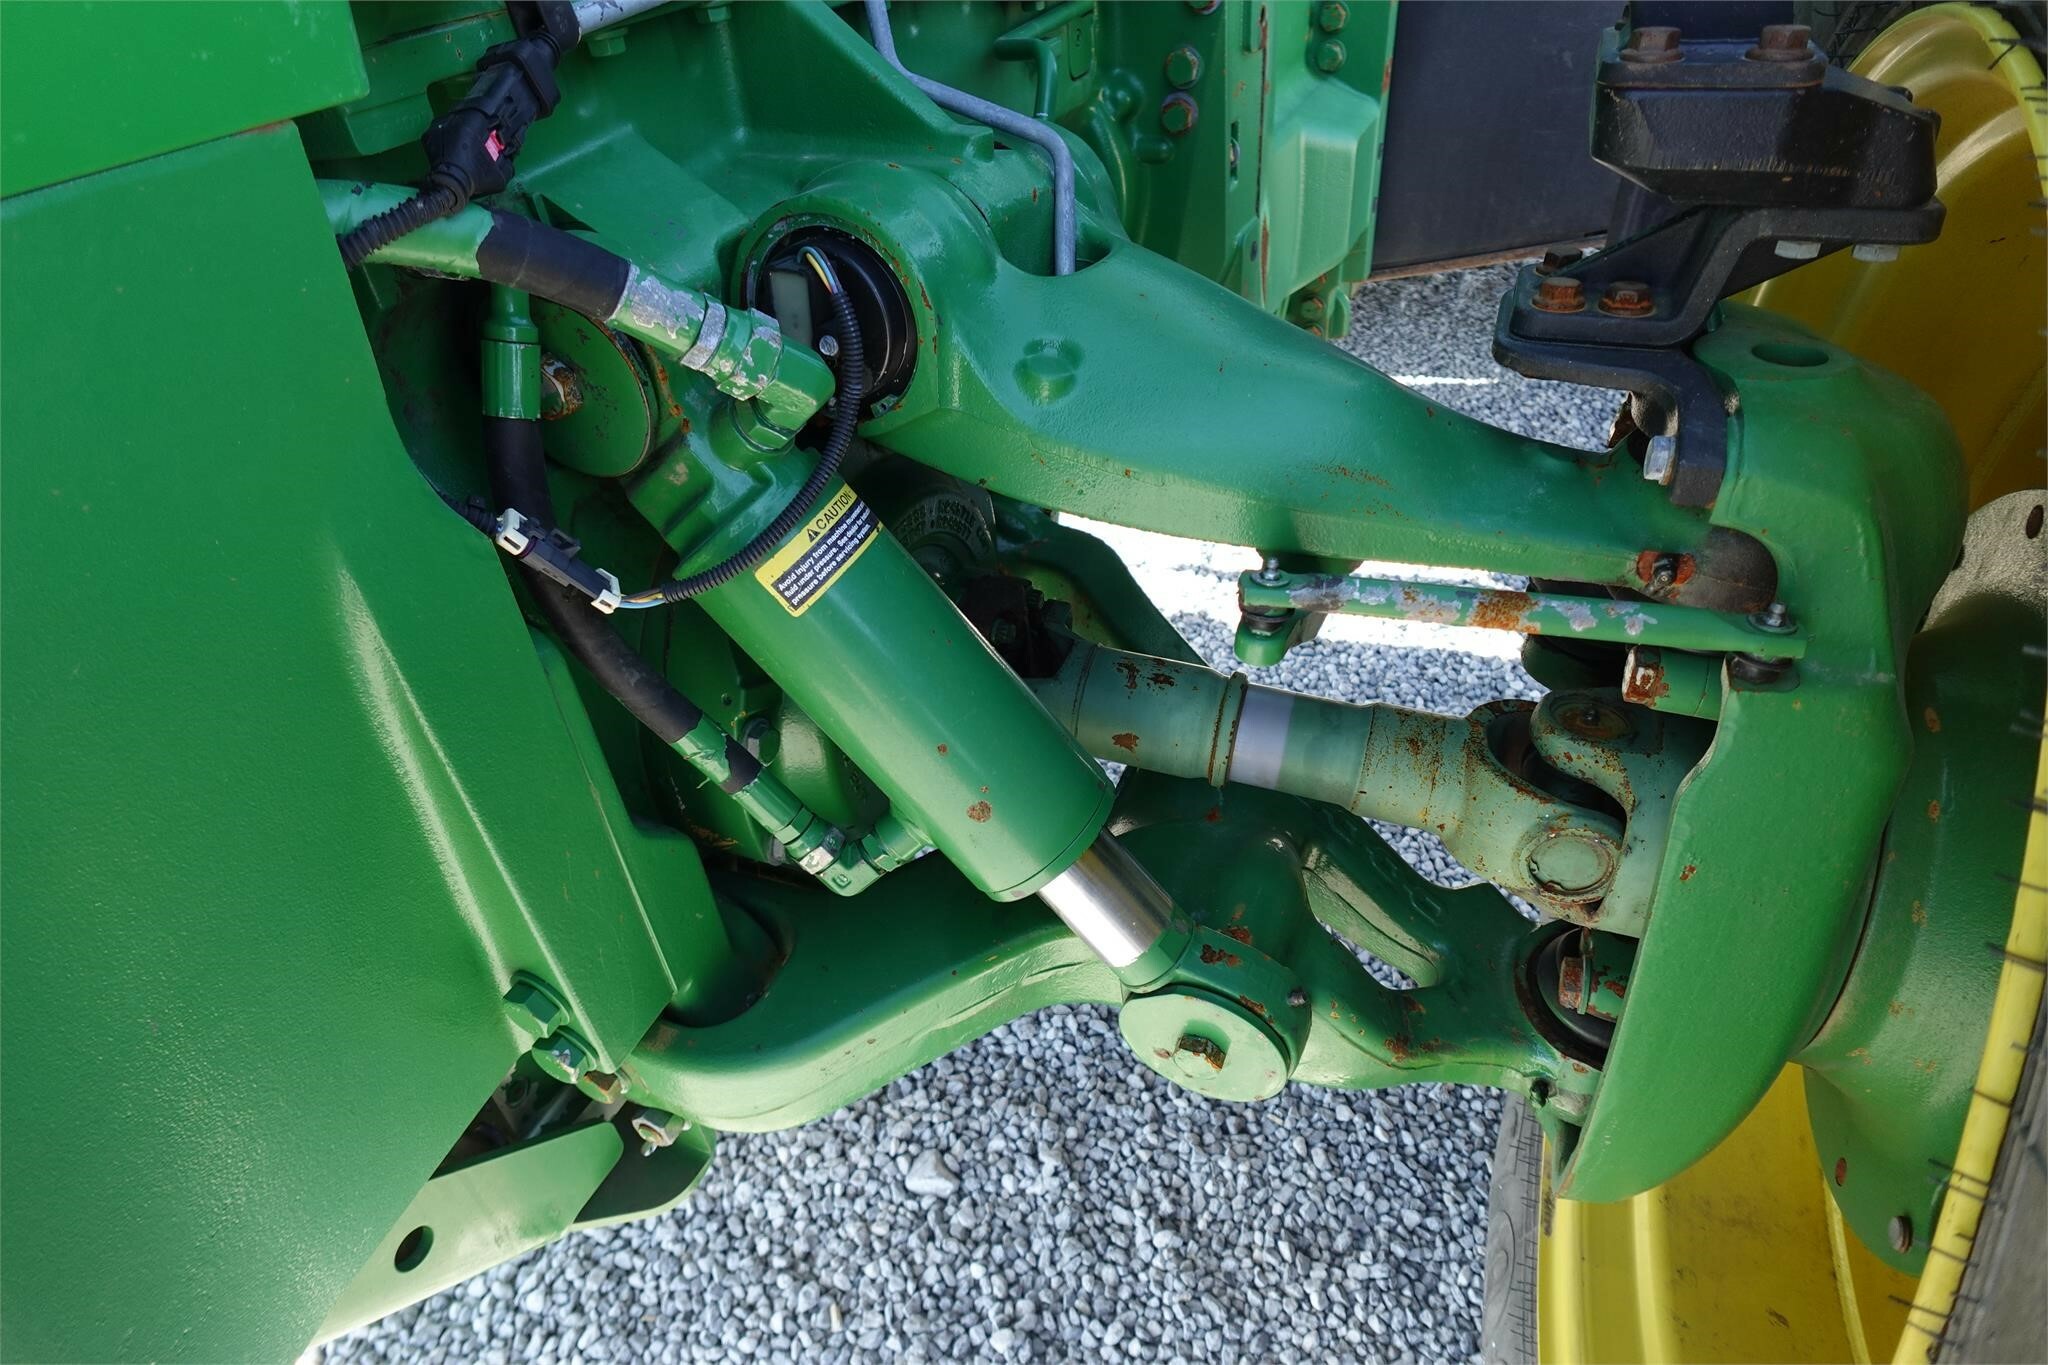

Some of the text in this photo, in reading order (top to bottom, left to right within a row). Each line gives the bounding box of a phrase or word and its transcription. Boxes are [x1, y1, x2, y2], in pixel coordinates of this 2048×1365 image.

[816, 490, 852, 530] CAUTION
[778, 572, 798, 591] Avoid
[795, 557, 815, 576] injury
[812, 543, 829, 559] from
[826, 523, 848, 546] machine
[784, 583, 799, 598] fluid
[797, 569, 814, 586] under
[813, 547, 839, 573] pressure.
[837, 536, 849, 547] See
[791, 579, 819, 606] pressure
[816, 560, 838, 580] before
[835, 537, 860, 562] servicing
